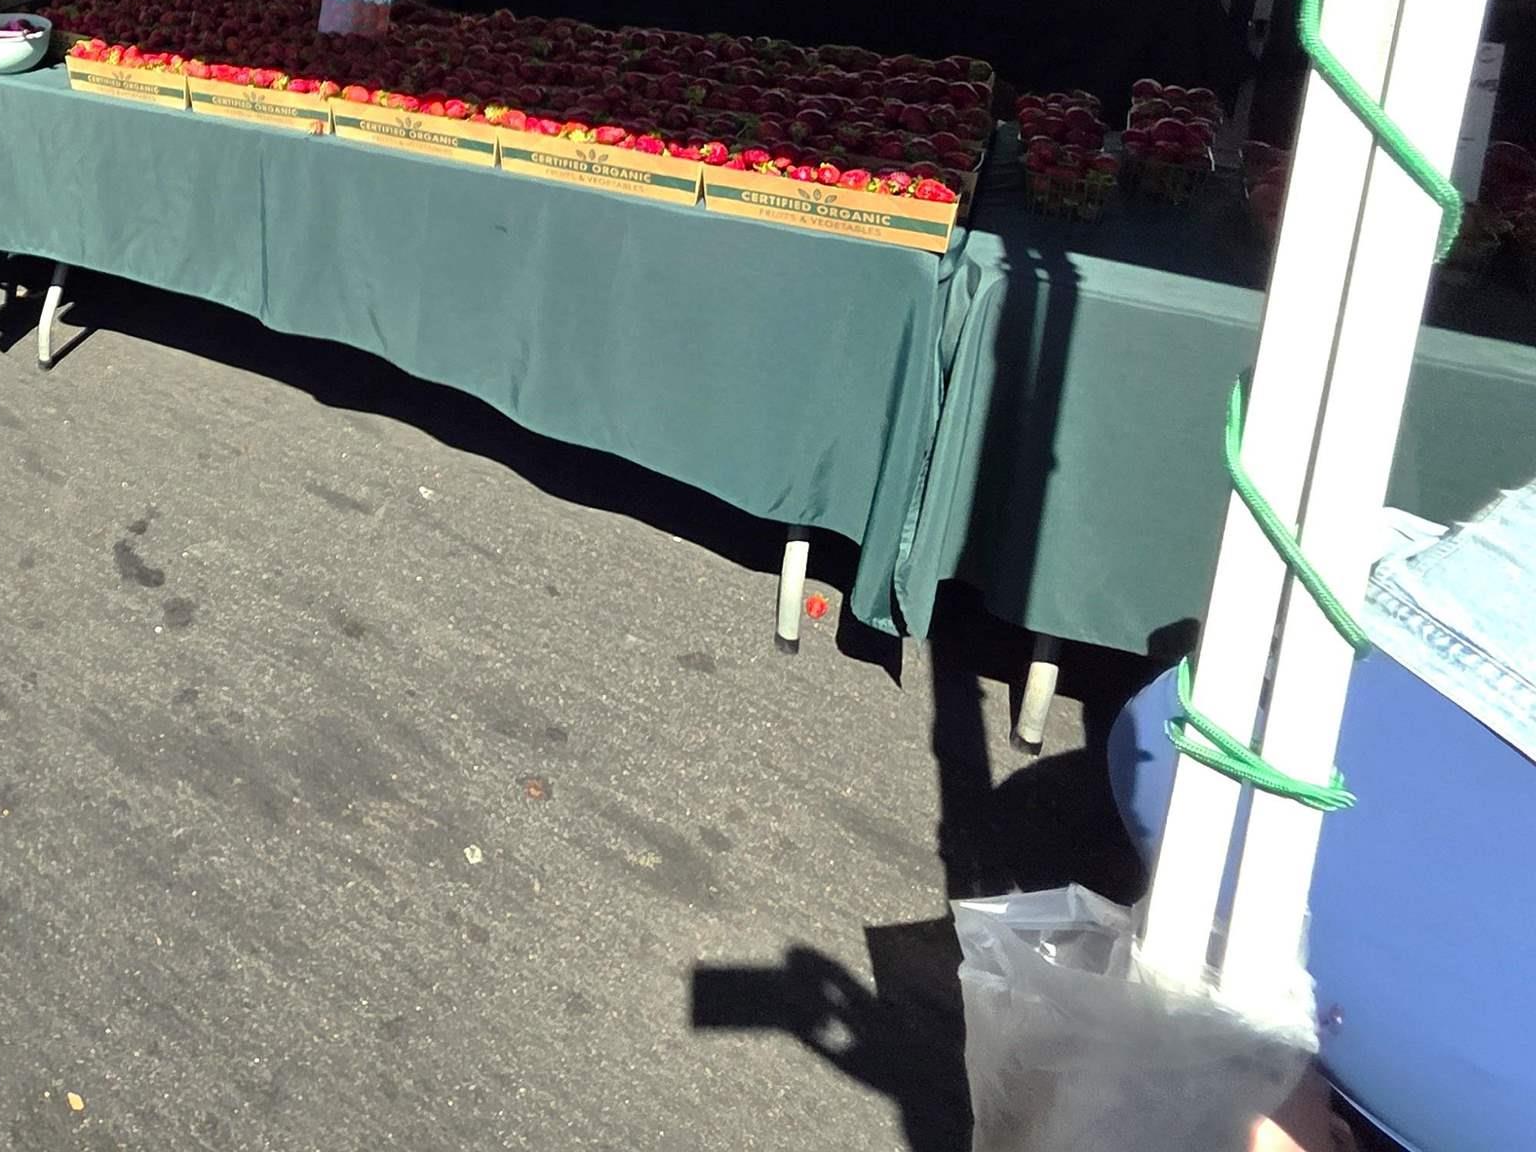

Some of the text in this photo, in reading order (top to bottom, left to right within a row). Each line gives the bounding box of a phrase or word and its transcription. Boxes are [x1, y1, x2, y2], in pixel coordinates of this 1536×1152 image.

[122, 81, 160, 95] ORGANIC
[211, 95, 299, 116] CERTIFIED ORGANIC
[359, 120, 406, 137] CERTIFIED
[408, 129, 459, 147] ORGANIC
[530, 152, 652, 184] CERTIFIED ORGANIC
[740, 190, 892, 227] CERTIFIED ORGANIC
[809, 217, 882, 237] VEGETABLES
